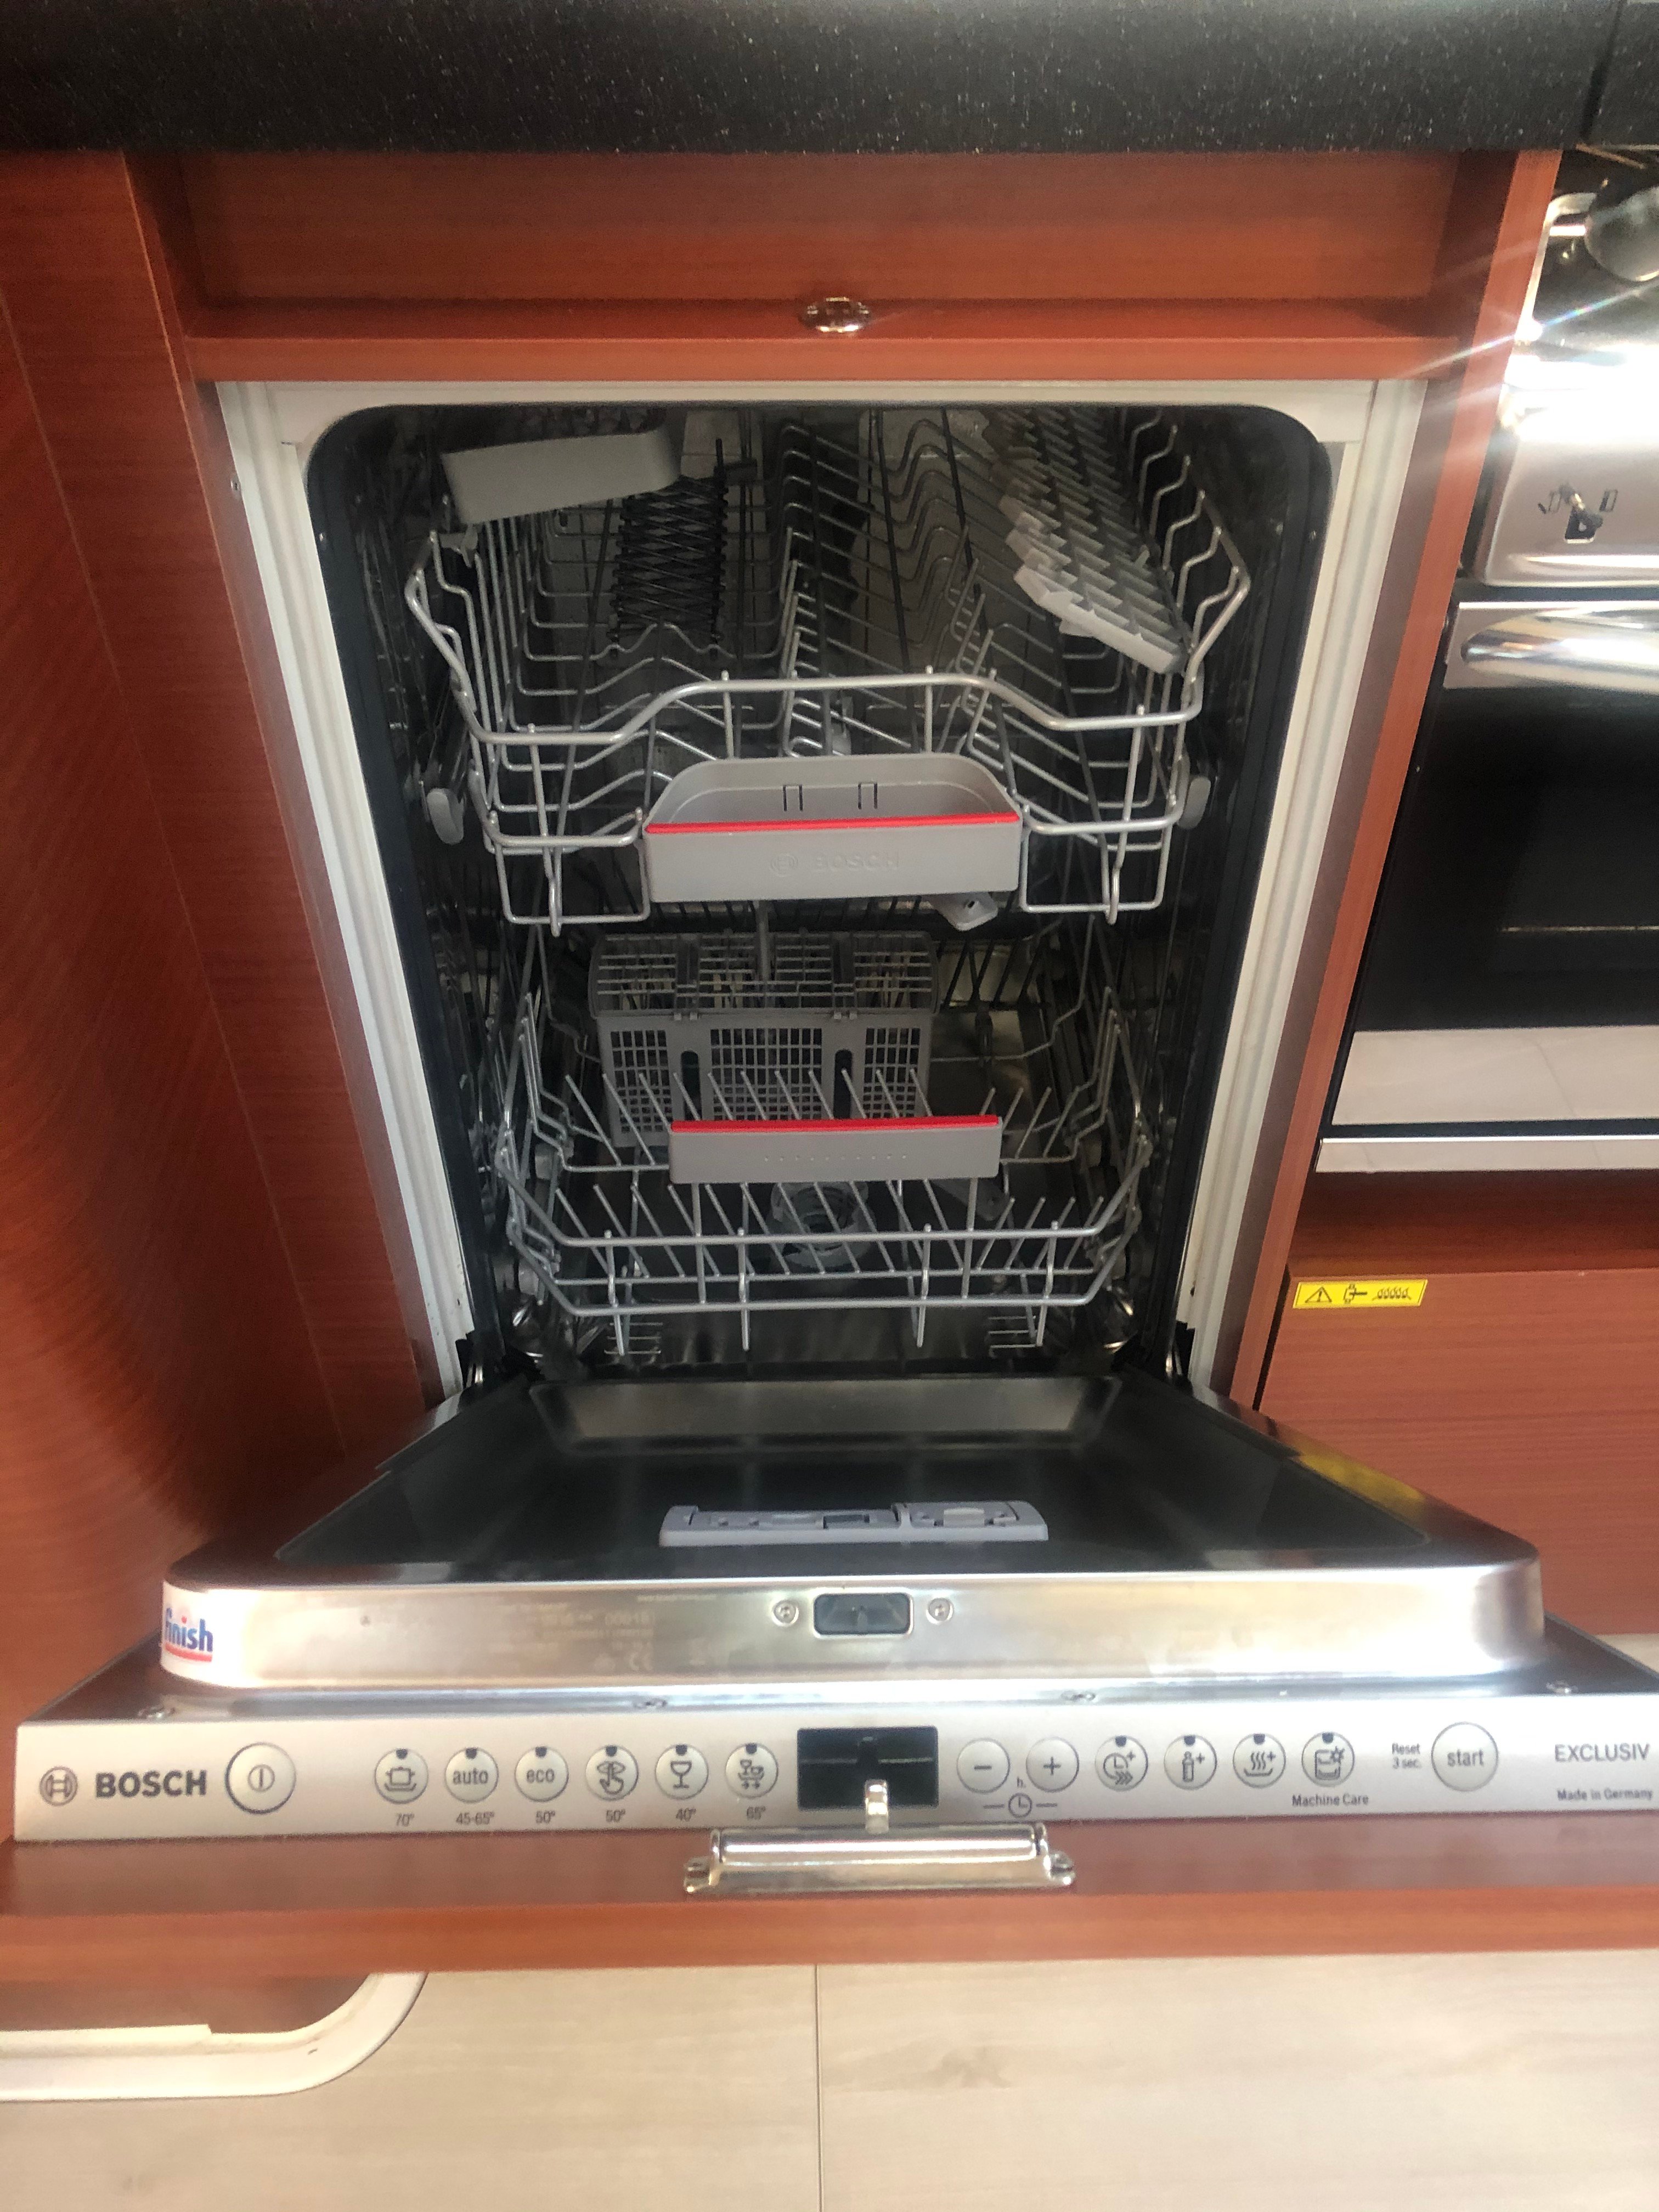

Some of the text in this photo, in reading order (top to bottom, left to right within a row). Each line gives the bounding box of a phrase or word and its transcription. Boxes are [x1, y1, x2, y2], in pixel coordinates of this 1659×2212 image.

[815, 851, 900, 872] BOSCH
[166, 1608, 213, 1652] finish
[1391, 1742, 1420, 1755] Reset
[1554, 1742, 1650, 1763] EXCLUSIV
[1447, 1749, 1485, 1767] start
[95, 1770, 207, 1798] BOSCH
[453, 1767, 489, 1785] auto
[527, 1768, 555, 1783] eco
[1292, 1792, 1369, 1807] Machine Care
[1557, 1787, 1653, 1802] Made in Germany
